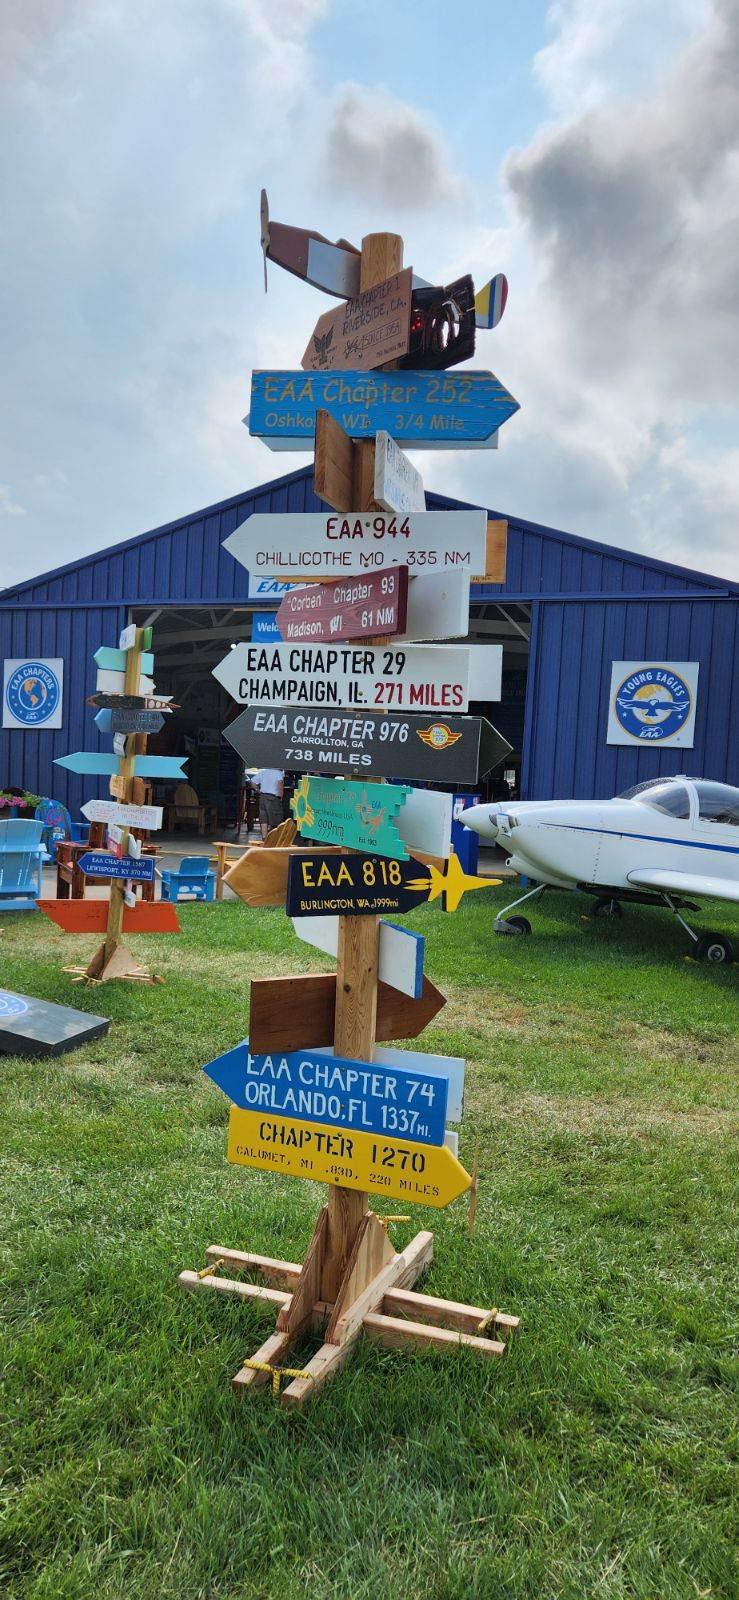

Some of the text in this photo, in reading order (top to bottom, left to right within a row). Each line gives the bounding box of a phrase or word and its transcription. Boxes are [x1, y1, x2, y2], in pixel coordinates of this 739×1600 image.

[264, 377, 473, 410] EAA Chapter 252
[264, 412, 315, 429] Oshko
[395, 414, 424, 430] 3/4
[430, 414, 465, 430] Mile
[326, 516, 411, 540] EAA 944
[255, 551, 353, 566] CHILLICOTHE
[359, 551, 385, 566] MO
[406, 550, 438, 566] 335
[444, 551, 471, 565] NM
[333, 583, 373, 604] Chapter
[381, 575, 395, 595] 93
[257, 622, 279, 632] Welc
[287, 620, 324, 638] Madison,
[361, 610, 373, 628] 61
[376, 606, 394, 627] NM
[247, 648, 406, 675] EAA CHAPTER 29
[11, 667, 55, 690] EAA CHAPTERS
[622, 671, 685, 697] YOUNG EAGLES
[239, 678, 463, 707] CHAMPAIGN, IL. 271 MILES
[253, 712, 288, 734] EAA
[293, 715, 376, 740] CHAPTER
[379, 721, 410, 743] 976
[291, 735, 364, 748] CARROLLTON, GA
[284, 748, 372, 766] 738 MILES
[302, 860, 402, 887] EAA 818
[246, 1053, 436, 1108] EAA CHAPTER 74
[348, 1098, 373, 1126] FL
[381, 1105, 420, 1135] 1337
[260, 1121, 426, 1173] CHAPTER 1270
[236, 1145, 290, 1165] CALUMET,
[300, 1158, 314, 1170] MI
[369, 1172, 391, 1187] 220
[399, 1179, 440, 1197] MILES
